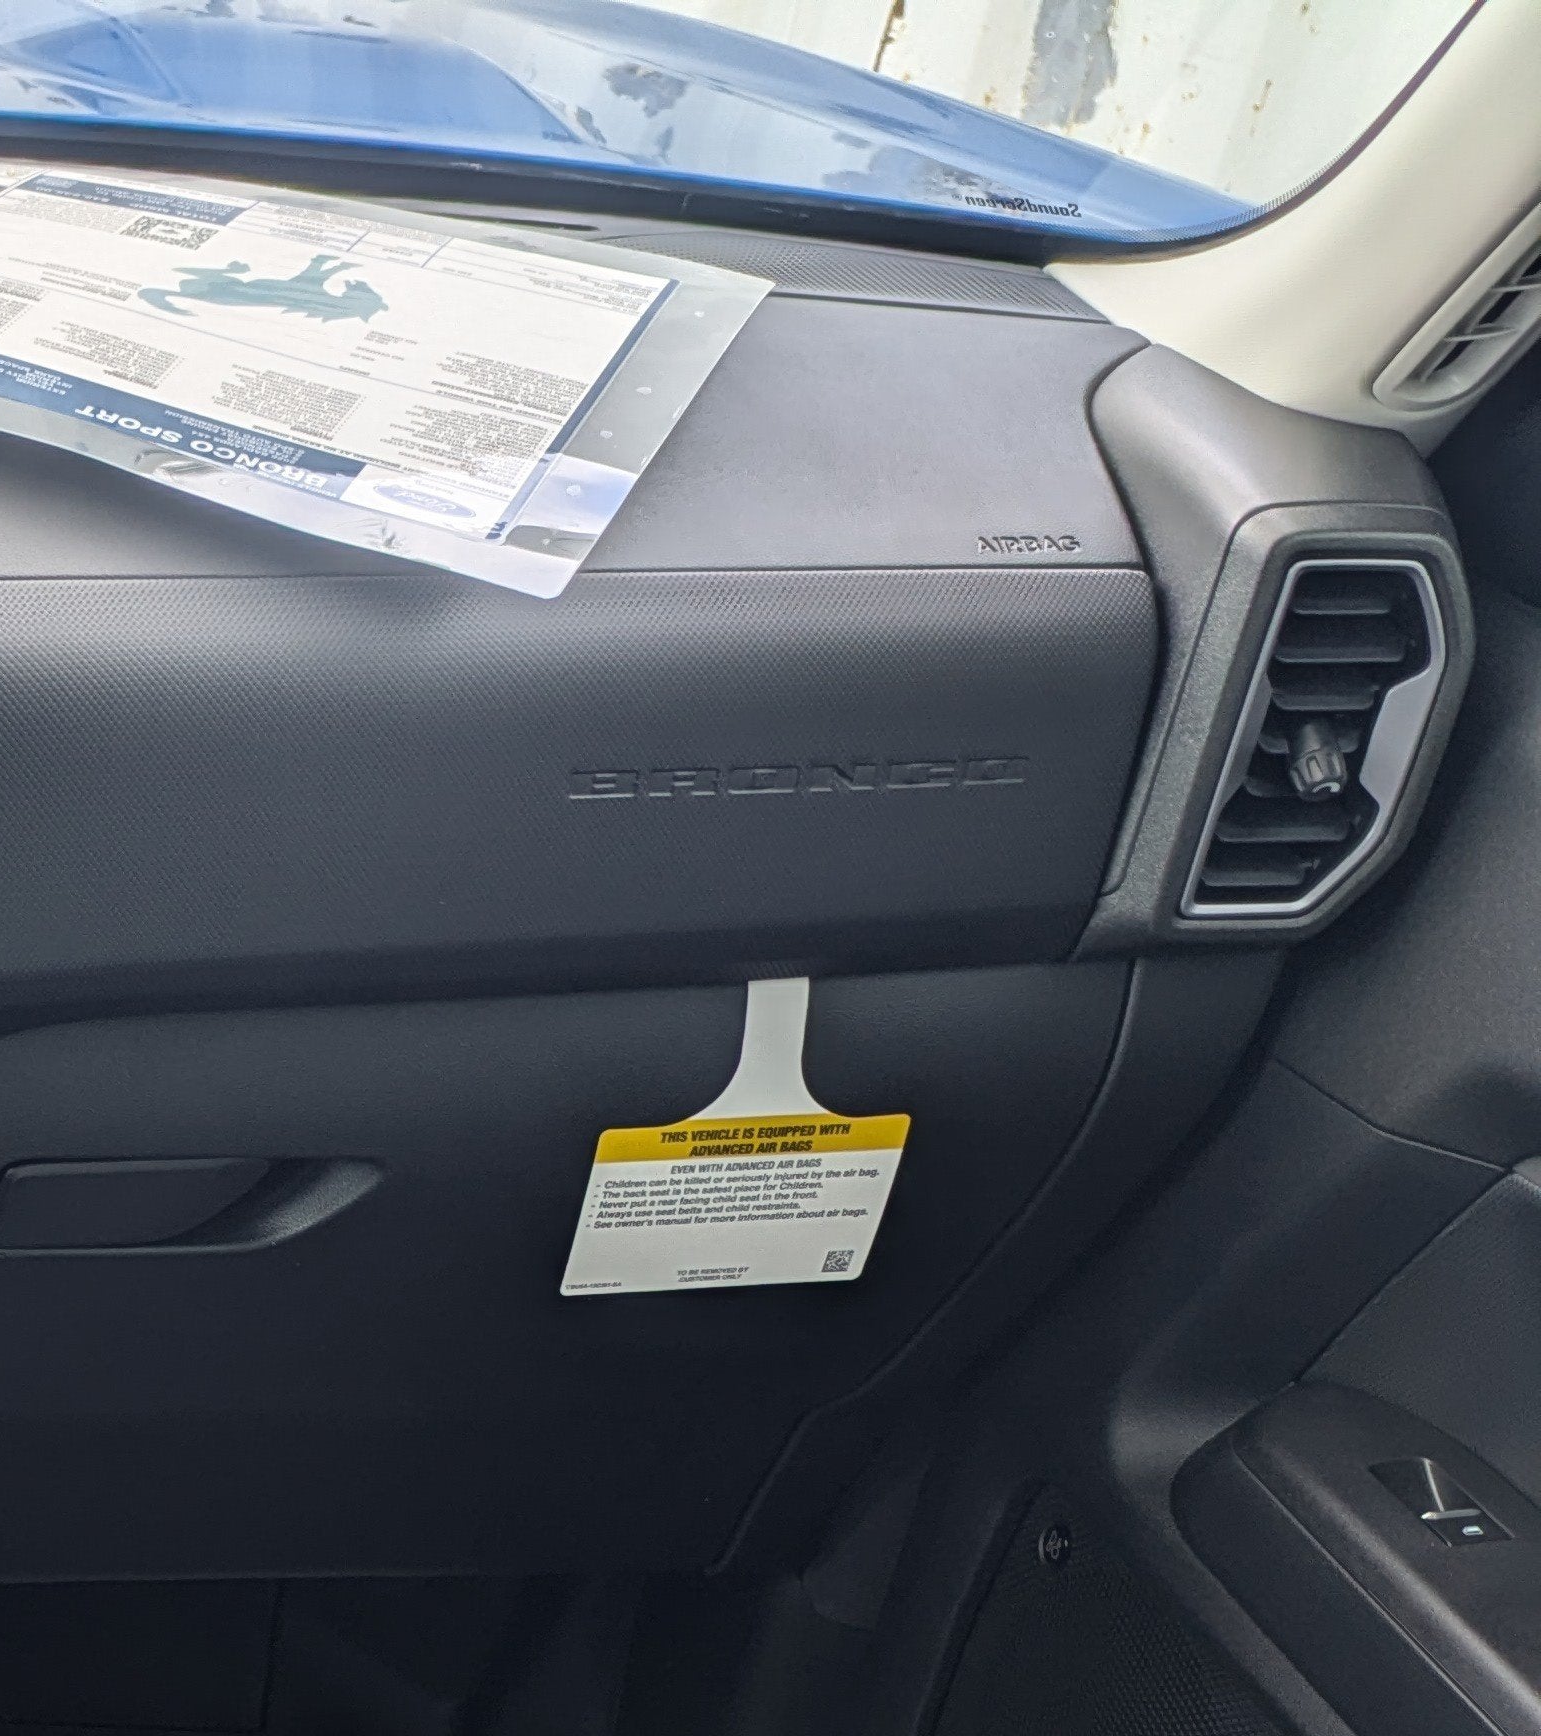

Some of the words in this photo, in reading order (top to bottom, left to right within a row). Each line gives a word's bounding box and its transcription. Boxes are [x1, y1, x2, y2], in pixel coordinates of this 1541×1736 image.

[74, 405, 184, 444] SPORT
[190, 440, 328, 488] BRONCO
[396, 488, 456, 515] Ford
[975, 534, 1081, 554] AIRBAG
[661, 1131, 688, 1143] THIS
[691, 1128, 740, 1141] VEHICLE
[742, 1128, 755, 1139] IS
[757, 1125, 816, 1139] EQUIPPED
[819, 1124, 851, 1136] WITH
[688, 1143, 754, 1157] ADVANCED
[756, 1142, 777, 1154] AIR
[780, 1140, 814, 1152] BAGS
[671, 1165, 696, 1175] EVEN
[698, 1163, 723, 1173] WITH
[724, 1162, 775, 1172] ADVANCED
[777, 1160, 795, 1169] AIR
[796, 1158, 822, 1168] BAGS
[604, 1179, 647, 1189] Children
[648, 1179, 667, 1187] can
[684, 1177, 711, 1185] killed
[726, 1174, 772, 1183] seriously
[811, 1171, 823, 1180] by
[825, 1170, 842, 1178] the
[843, 1169, 856, 1177] air
[858, 1168, 880, 1178] bag.
[599, 1201, 628, 1209] Never
[630, 1199, 647, 1210] put
[679, 1196, 710, 1206] facing
[712, 1195, 736, 1204] child
[739, 1193, 760, 1203] seat
[774, 1191, 790, 1200] the
[792, 1190, 819, 1200] front.
[602, 1190, 620, 1199] The
[622, 1189, 647, 1198] back
[649, 1188, 670, 1197] seat
[683, 1186, 700, 1195] the
[701, 1185, 732, 1194] safest
[733, 1183, 760, 1193] place
[762, 1182, 778, 1191] for
[779, 1181, 824, 1190] Children.
[593, 1220, 613, 1229] See
[614, 1218, 653, 1228] owner's
[656, 1216, 693, 1226] manual
[694, 1215, 708, 1224] for
[710, 1214, 736, 1223] more
[738, 1211, 794, 1221] information
[796, 1209, 825, 1219] about
[826, 1208, 840, 1217] air
[842, 1207, 868, 1218] bags.
[596, 1210, 632, 1219] Always
[634, 1209, 653, 1217] use
[655, 1207, 676, 1216] seat
[678, 1205, 702, 1215] belts
[725, 1203, 749, 1213] child
[751, 1200, 801, 1211] restraints.
